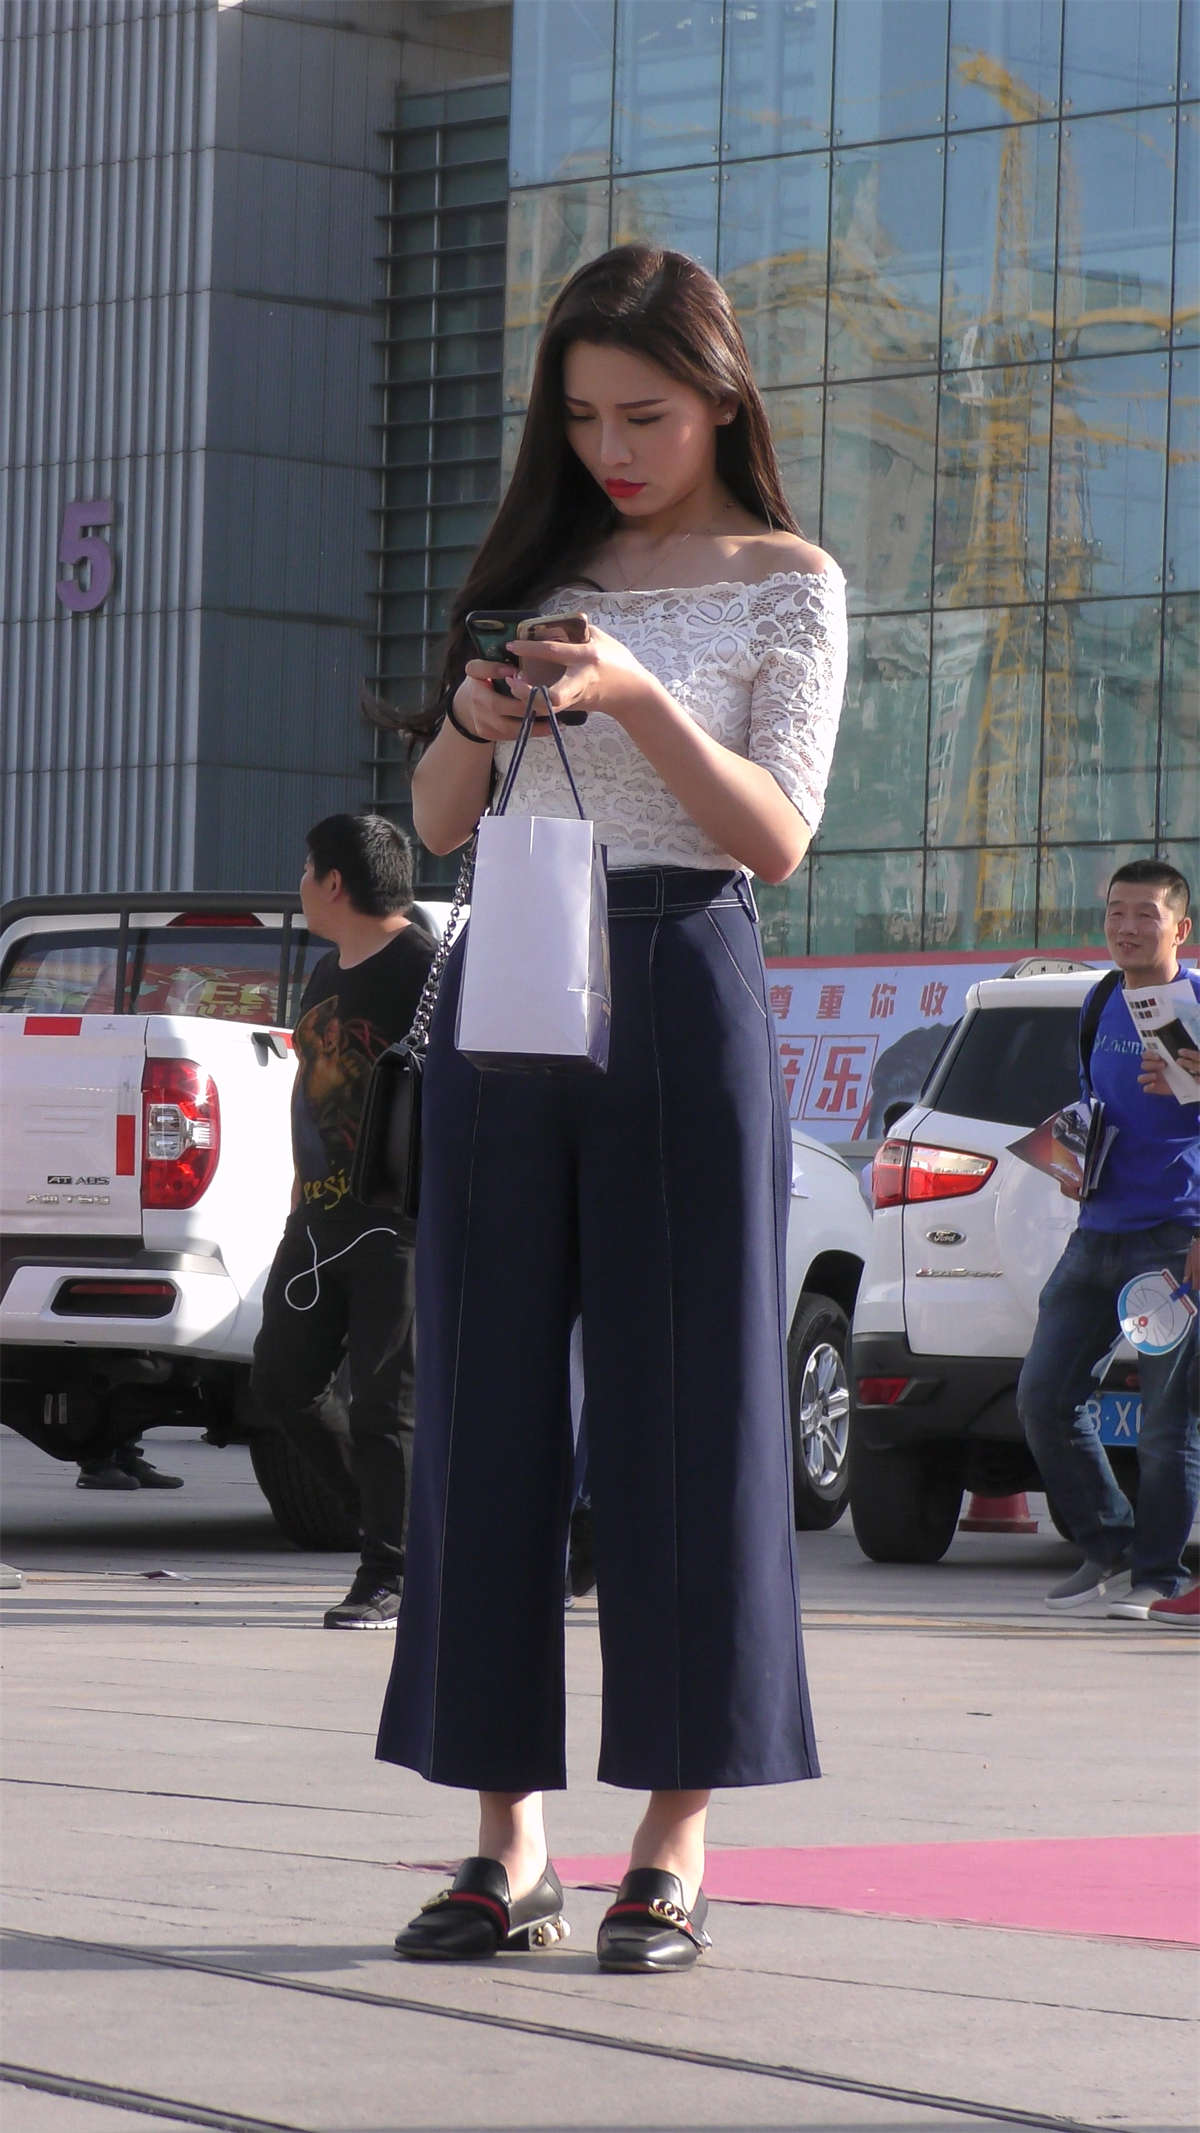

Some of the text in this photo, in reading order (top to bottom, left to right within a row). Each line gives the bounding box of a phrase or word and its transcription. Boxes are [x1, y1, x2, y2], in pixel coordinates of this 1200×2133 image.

[57, 501, 113, 612] 5
[769, 981, 949, 1020] 尊重你收
